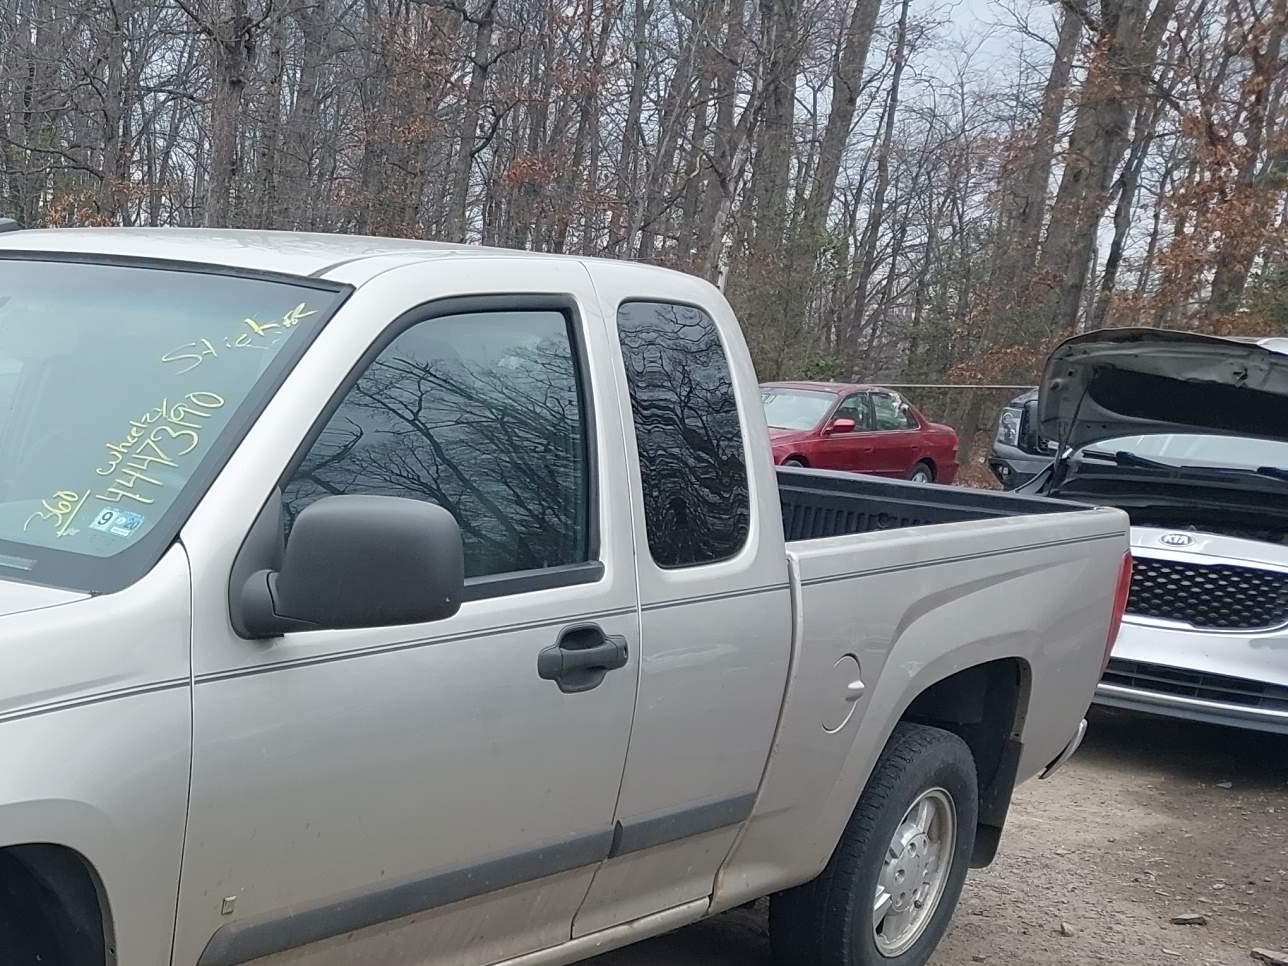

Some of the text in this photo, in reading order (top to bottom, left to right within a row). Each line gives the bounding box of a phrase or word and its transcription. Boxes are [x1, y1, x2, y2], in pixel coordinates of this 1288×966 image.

[96, 391, 225, 504] 44473190
[97, 511, 114, 526] 9
[1164, 535, 1188, 544] KIA
